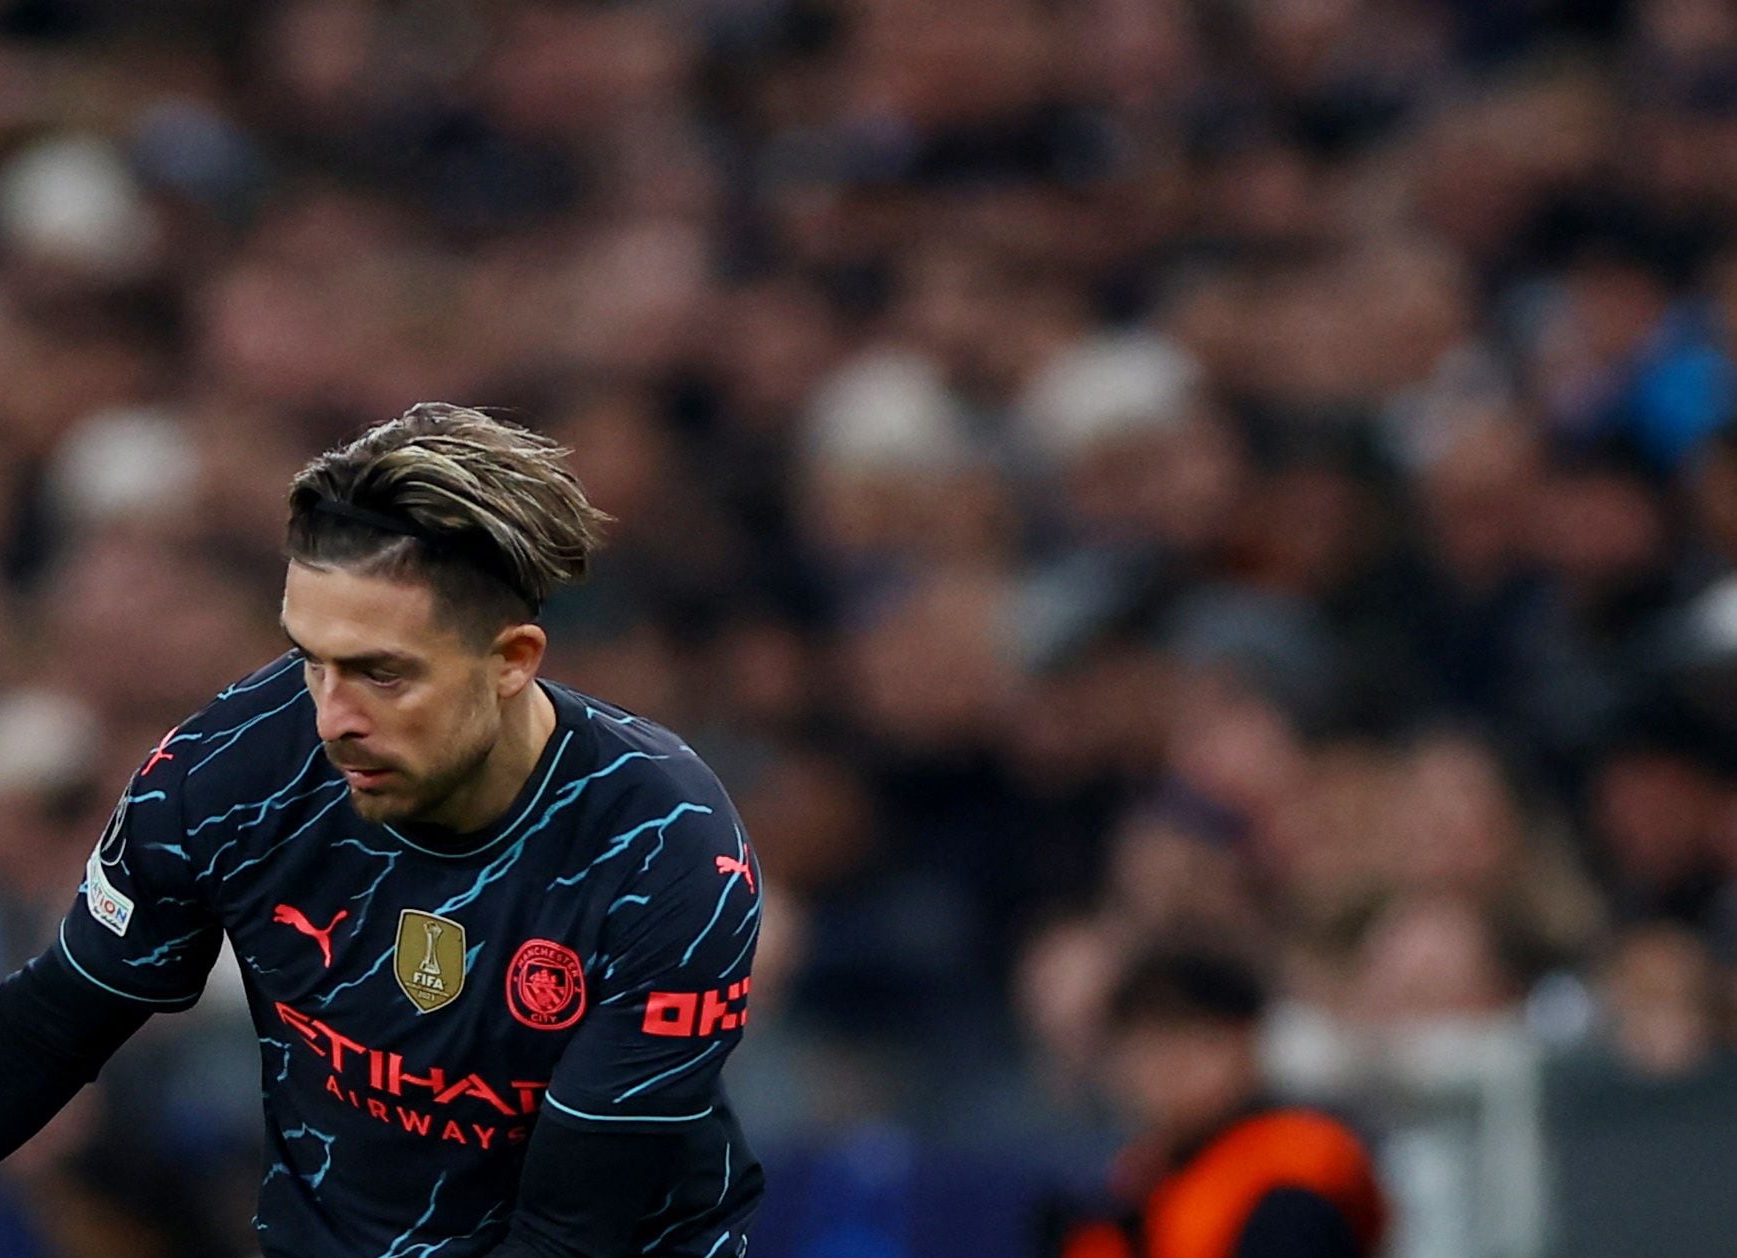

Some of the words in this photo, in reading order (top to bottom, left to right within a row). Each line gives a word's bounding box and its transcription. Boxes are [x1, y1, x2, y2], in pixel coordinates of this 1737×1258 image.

[518, 945, 578, 978] MANCHESTER
[413, 971, 445, 990] FIFA
[530, 1012, 558, 1025] CITY
[641, 976, 751, 1037] OK
[325, 1074, 528, 1151] AIRWAYS
